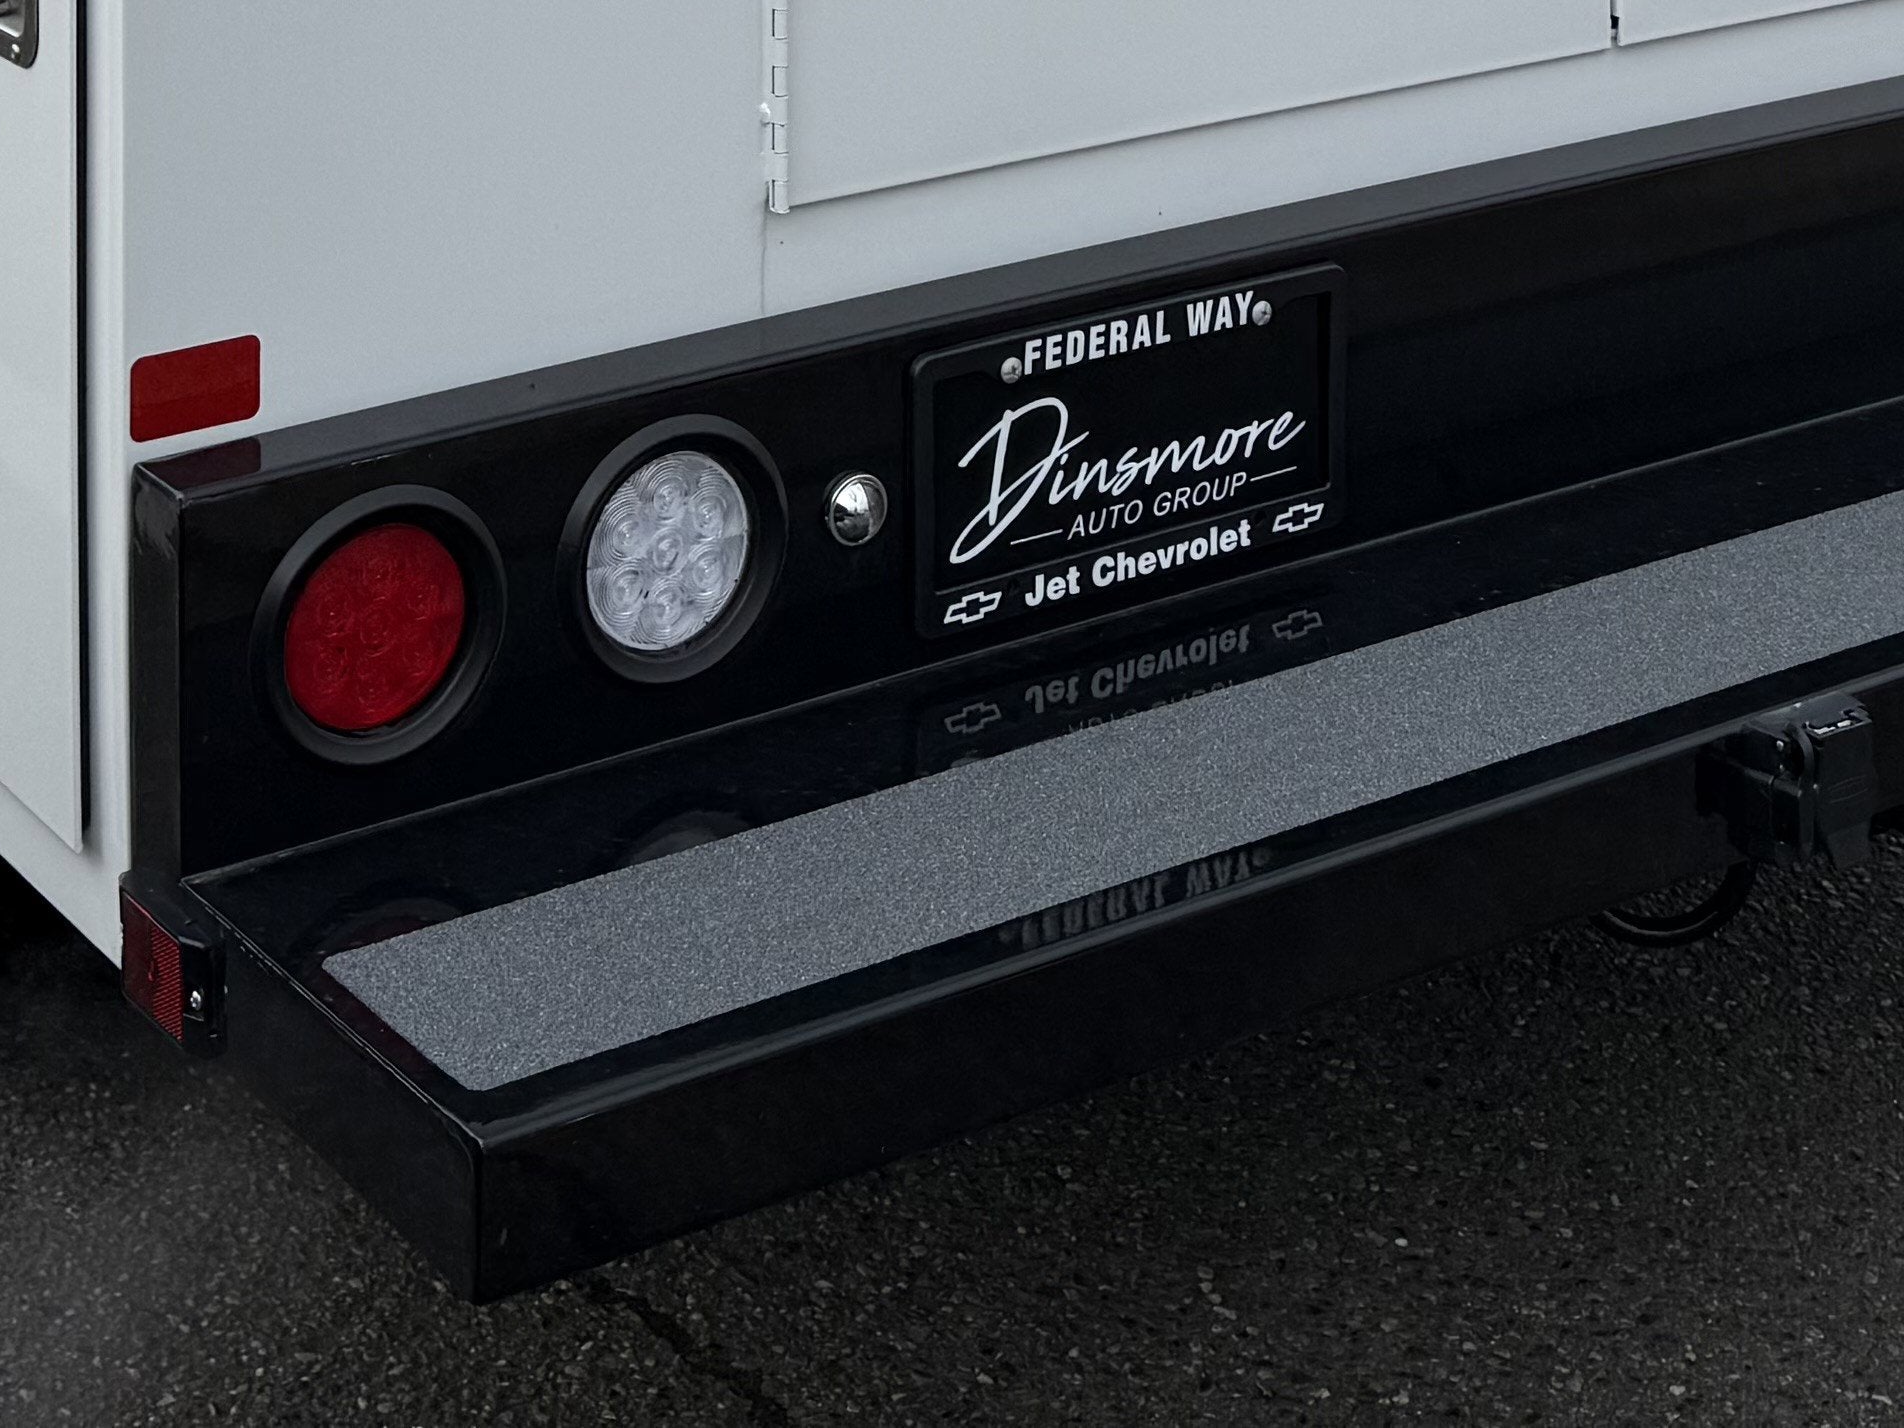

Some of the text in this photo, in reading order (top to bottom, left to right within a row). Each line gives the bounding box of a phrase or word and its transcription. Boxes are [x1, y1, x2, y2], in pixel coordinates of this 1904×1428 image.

[1023, 290, 1254, 376] FEDERAL WAY
[948, 396, 1306, 564] Dinsmore
[1067, 471, 1247, 541] AUTO GROUP
[1024, 518, 1251, 607] Jet Chevrolet
